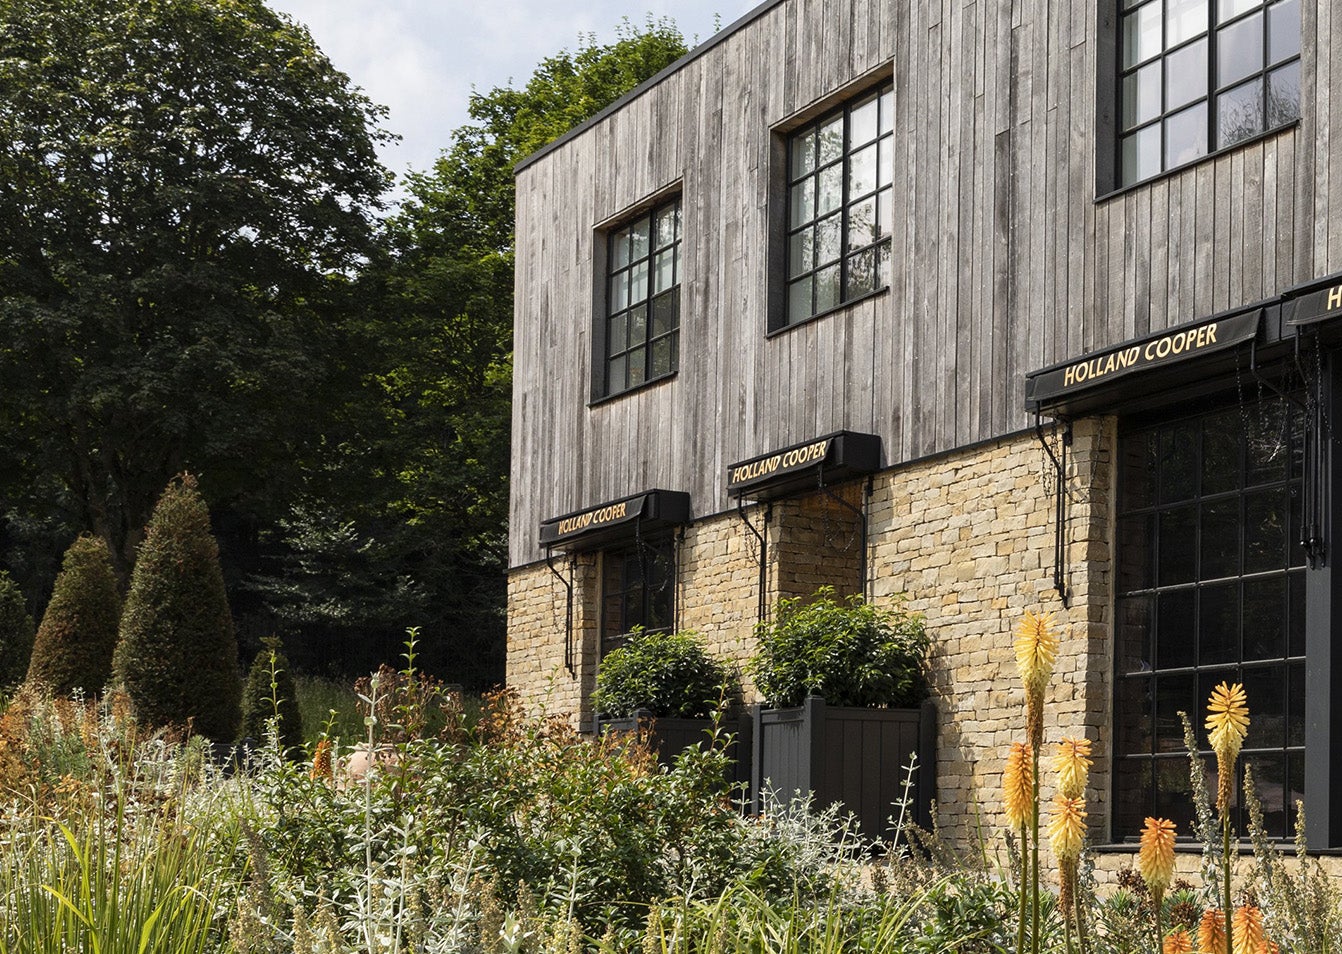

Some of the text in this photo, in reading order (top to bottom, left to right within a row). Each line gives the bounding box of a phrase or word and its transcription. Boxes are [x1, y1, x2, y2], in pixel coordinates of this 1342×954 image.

[1064, 323, 1217, 386] HOLLAND COOPER
[732, 441, 827, 483] HOLLAND COOPER
[558, 502, 626, 535] HOLLAND COOPER
